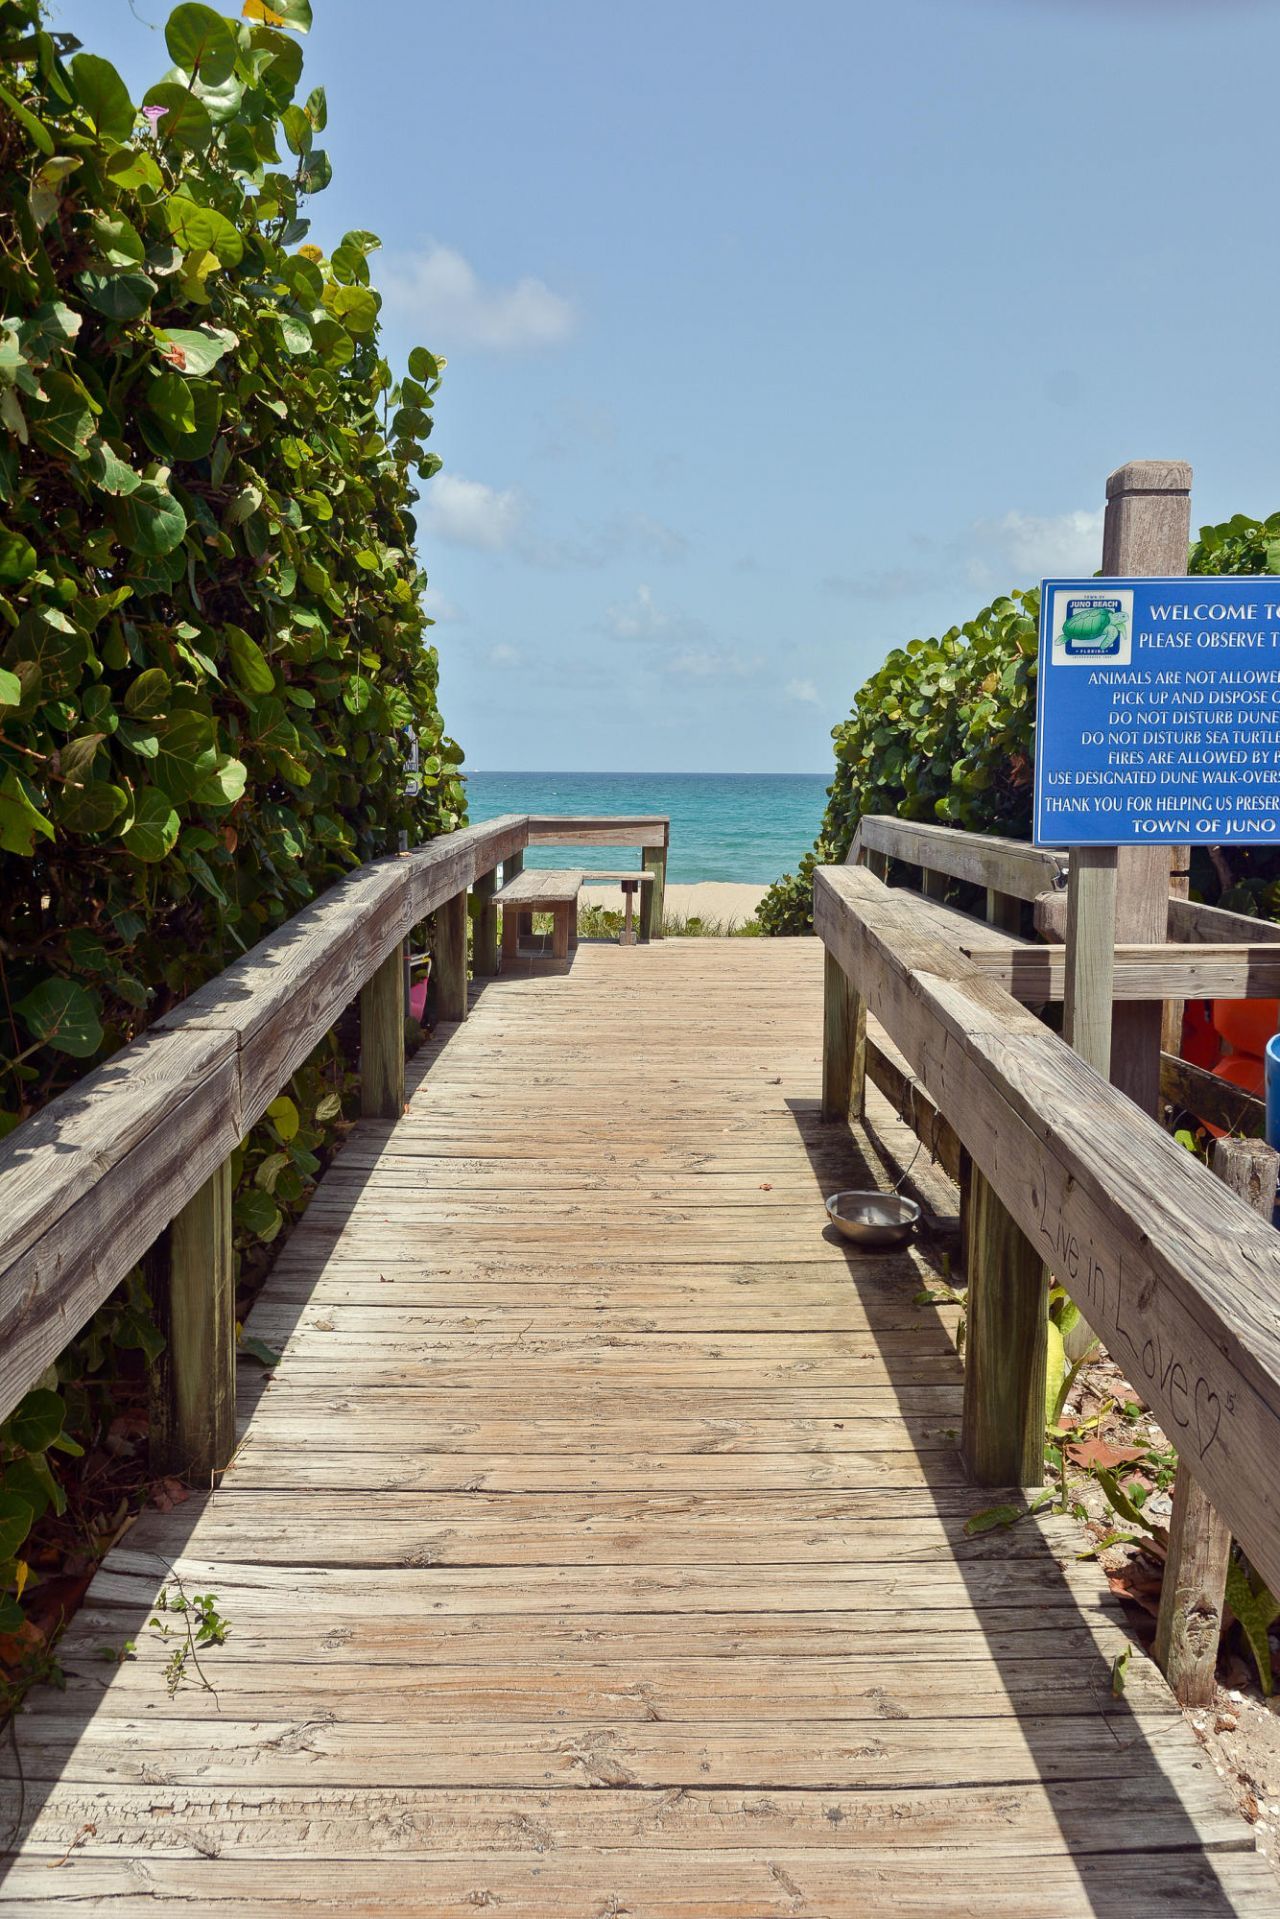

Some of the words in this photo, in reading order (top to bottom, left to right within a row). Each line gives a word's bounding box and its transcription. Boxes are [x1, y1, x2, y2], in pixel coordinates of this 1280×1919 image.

[1150, 605, 1257, 620] WELCOME
[1264, 605, 1280, 619] T
[1140, 633, 1192, 648] PLEASE
[1197, 632, 1264, 647] OBSERVE
[1089, 672, 1151, 684] ANIMALS
[1155, 672, 1180, 684] ARE
[1186, 671, 1216, 684] NOT
[1219, 671, 1280, 683] ALLOWE
[1113, 692, 1144, 704] PICK
[1150, 692, 1168, 704] UP
[1171, 692, 1204, 704] AND
[1209, 691, 1267, 703] DISPOSE
[1109, 712, 1132, 724] DO
[1137, 712, 1168, 724] NOT
[1173, 711, 1232, 724] DISTURB
[1238, 711, 1279, 723] DUNE
[1082, 732, 1104, 744] DO
[1109, 732, 1139, 744] NOT
[1144, 731, 1201, 744] DISTURB
[1206, 731, 1229, 743] SEA
[1109, 752, 1144, 764] FIRES
[1148, 752, 1174, 764] ARE
[1178, 751, 1247, 763] ALLOWED
[1252, 751, 1269, 763] BY
[1049, 772, 1071, 784] USE
[1076, 771, 1156, 784] DESIGNATED
[1161, 771, 1198, 783] DUNE
[1045, 797, 1090, 811] THANK
[1095, 797, 1122, 811] YOU
[1127, 797, 1152, 811] FOR
[1157, 796, 1212, 810] HELPING
[1216, 796, 1232, 810] US
[1236, 796, 1280, 810] PRESER
[1132, 820, 1190, 832] TOWN
[1196, 819, 1220, 832] OF
[1225, 819, 1276, 834] JUNO
[1087, 1237, 1105, 1315] in
[1116, 1255, 1189, 1427] Love
